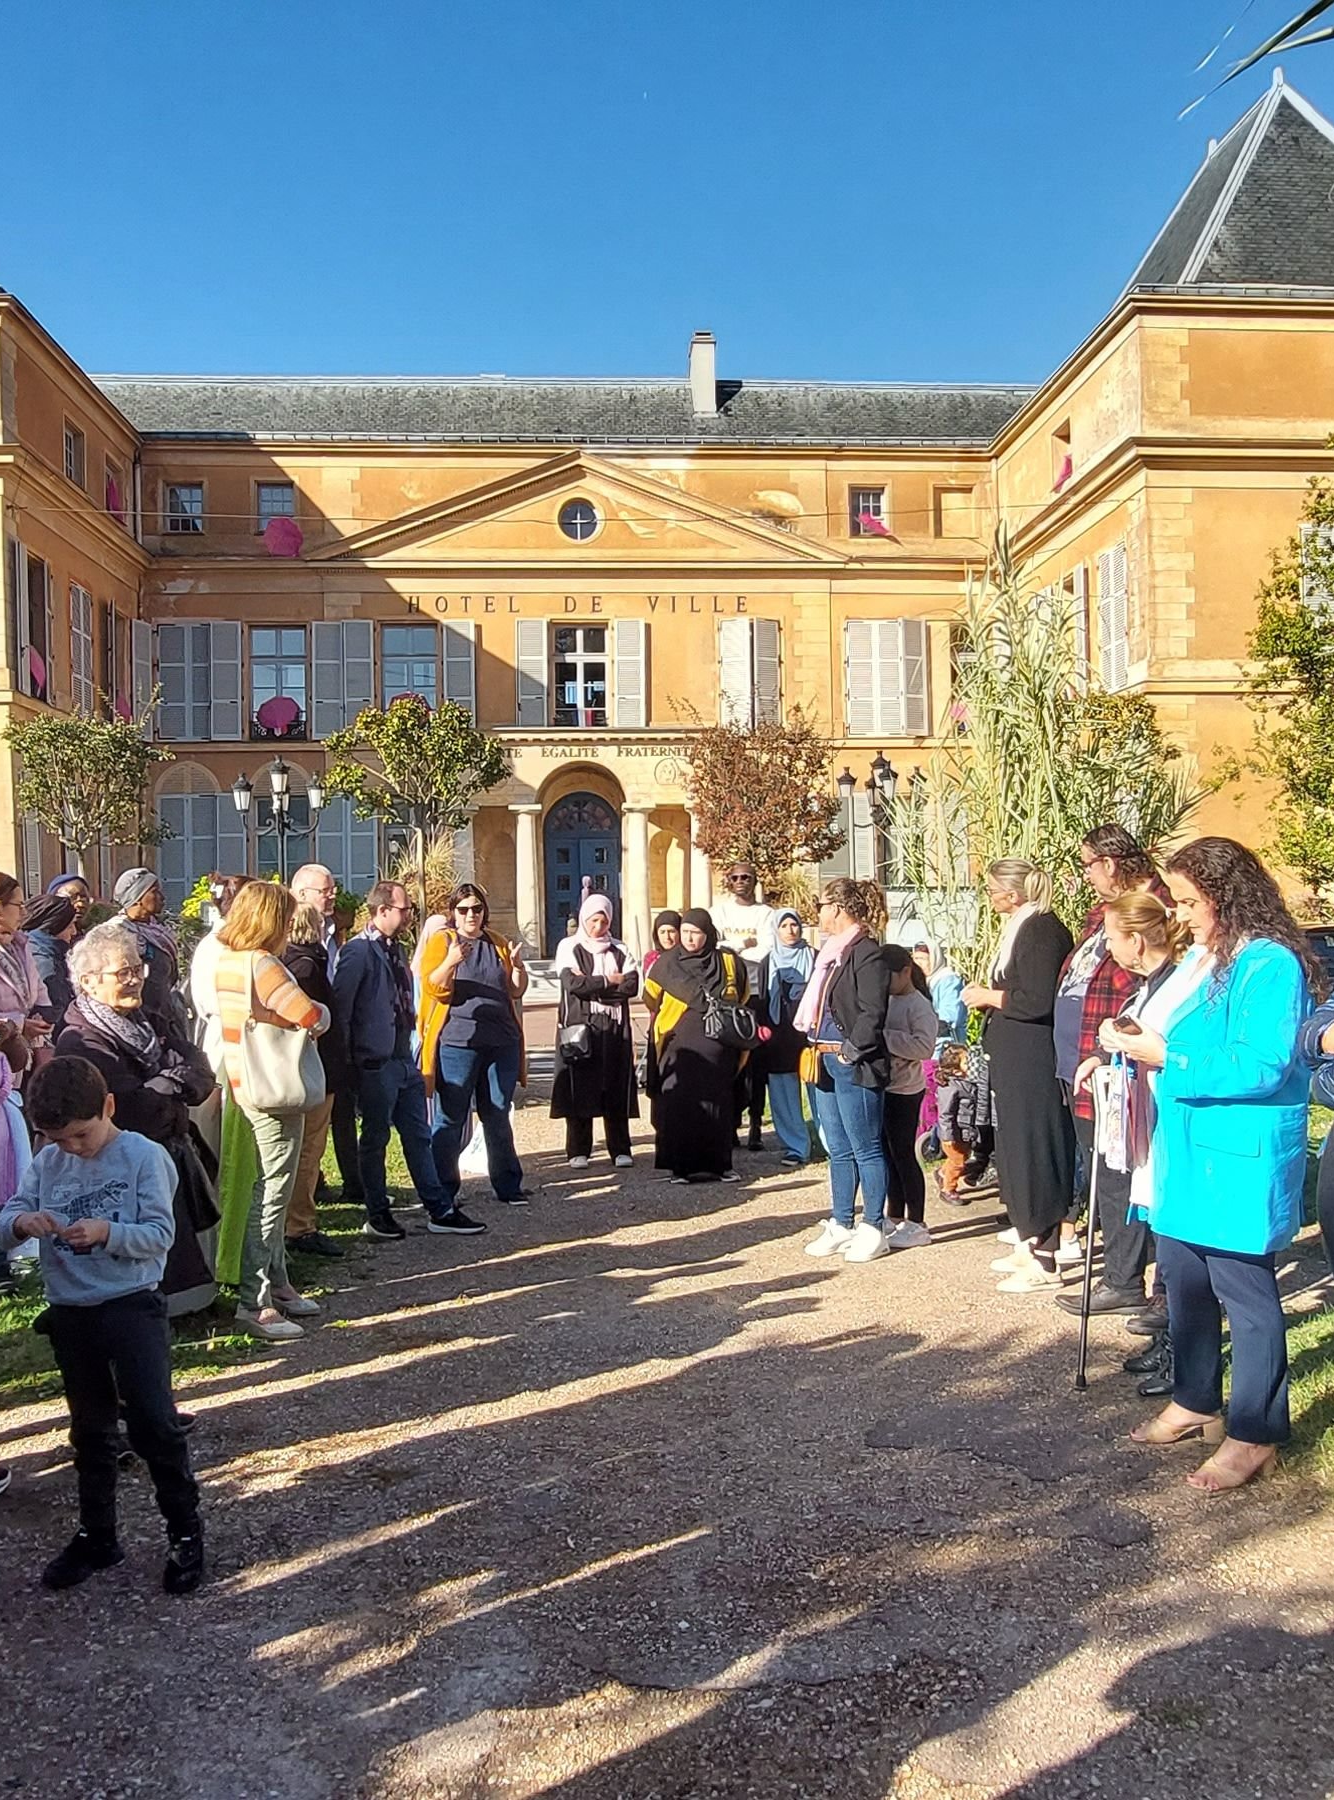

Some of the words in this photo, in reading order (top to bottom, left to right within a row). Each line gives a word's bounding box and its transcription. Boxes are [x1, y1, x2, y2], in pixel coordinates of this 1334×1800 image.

[408, 595, 520, 614] HOTEL
[564, 595, 603, 614] DE
[646, 595, 748, 614] VILLE
[616, 746, 694, 757] FRATERNIT
